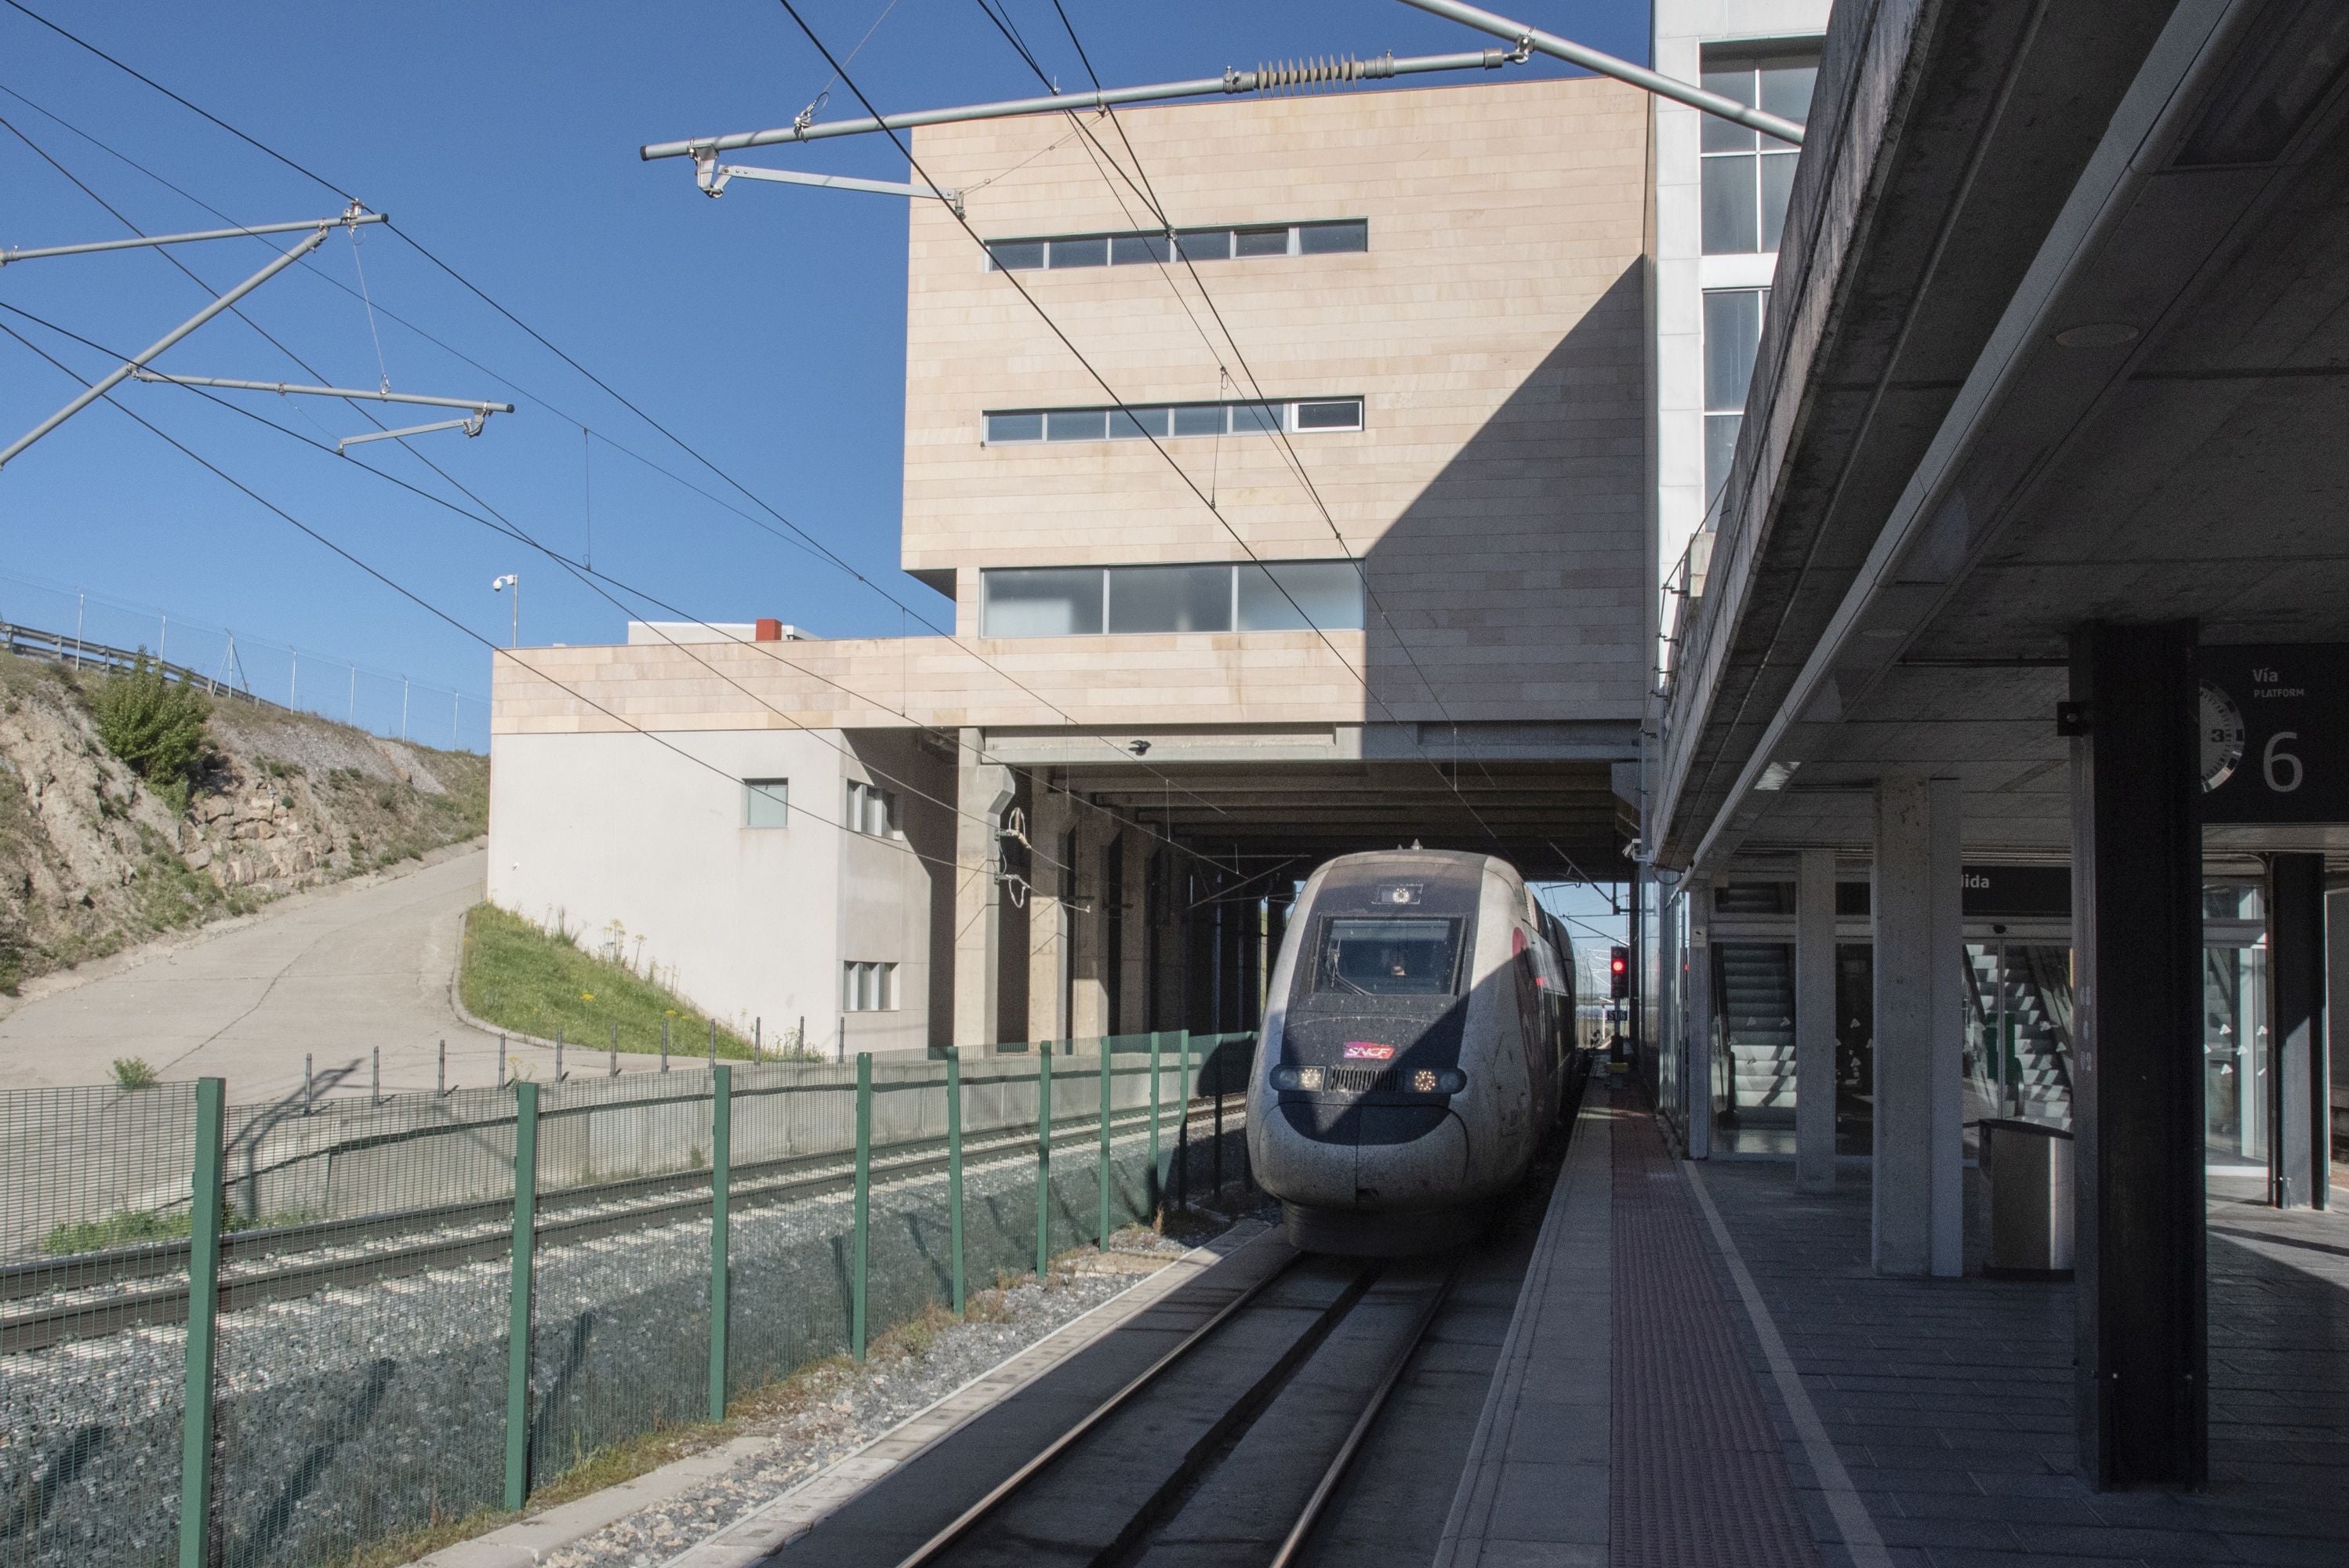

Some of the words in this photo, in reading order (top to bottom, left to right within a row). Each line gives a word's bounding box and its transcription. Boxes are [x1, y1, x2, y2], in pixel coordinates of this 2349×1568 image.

[2252, 667, 2279, 683] Vía
[2253, 688, 2305, 699] PLATFORM
[2211, 729, 2224, 743] 3
[2263, 731, 2304, 793] 6
[1345, 1046, 1392, 1057] SNCF
